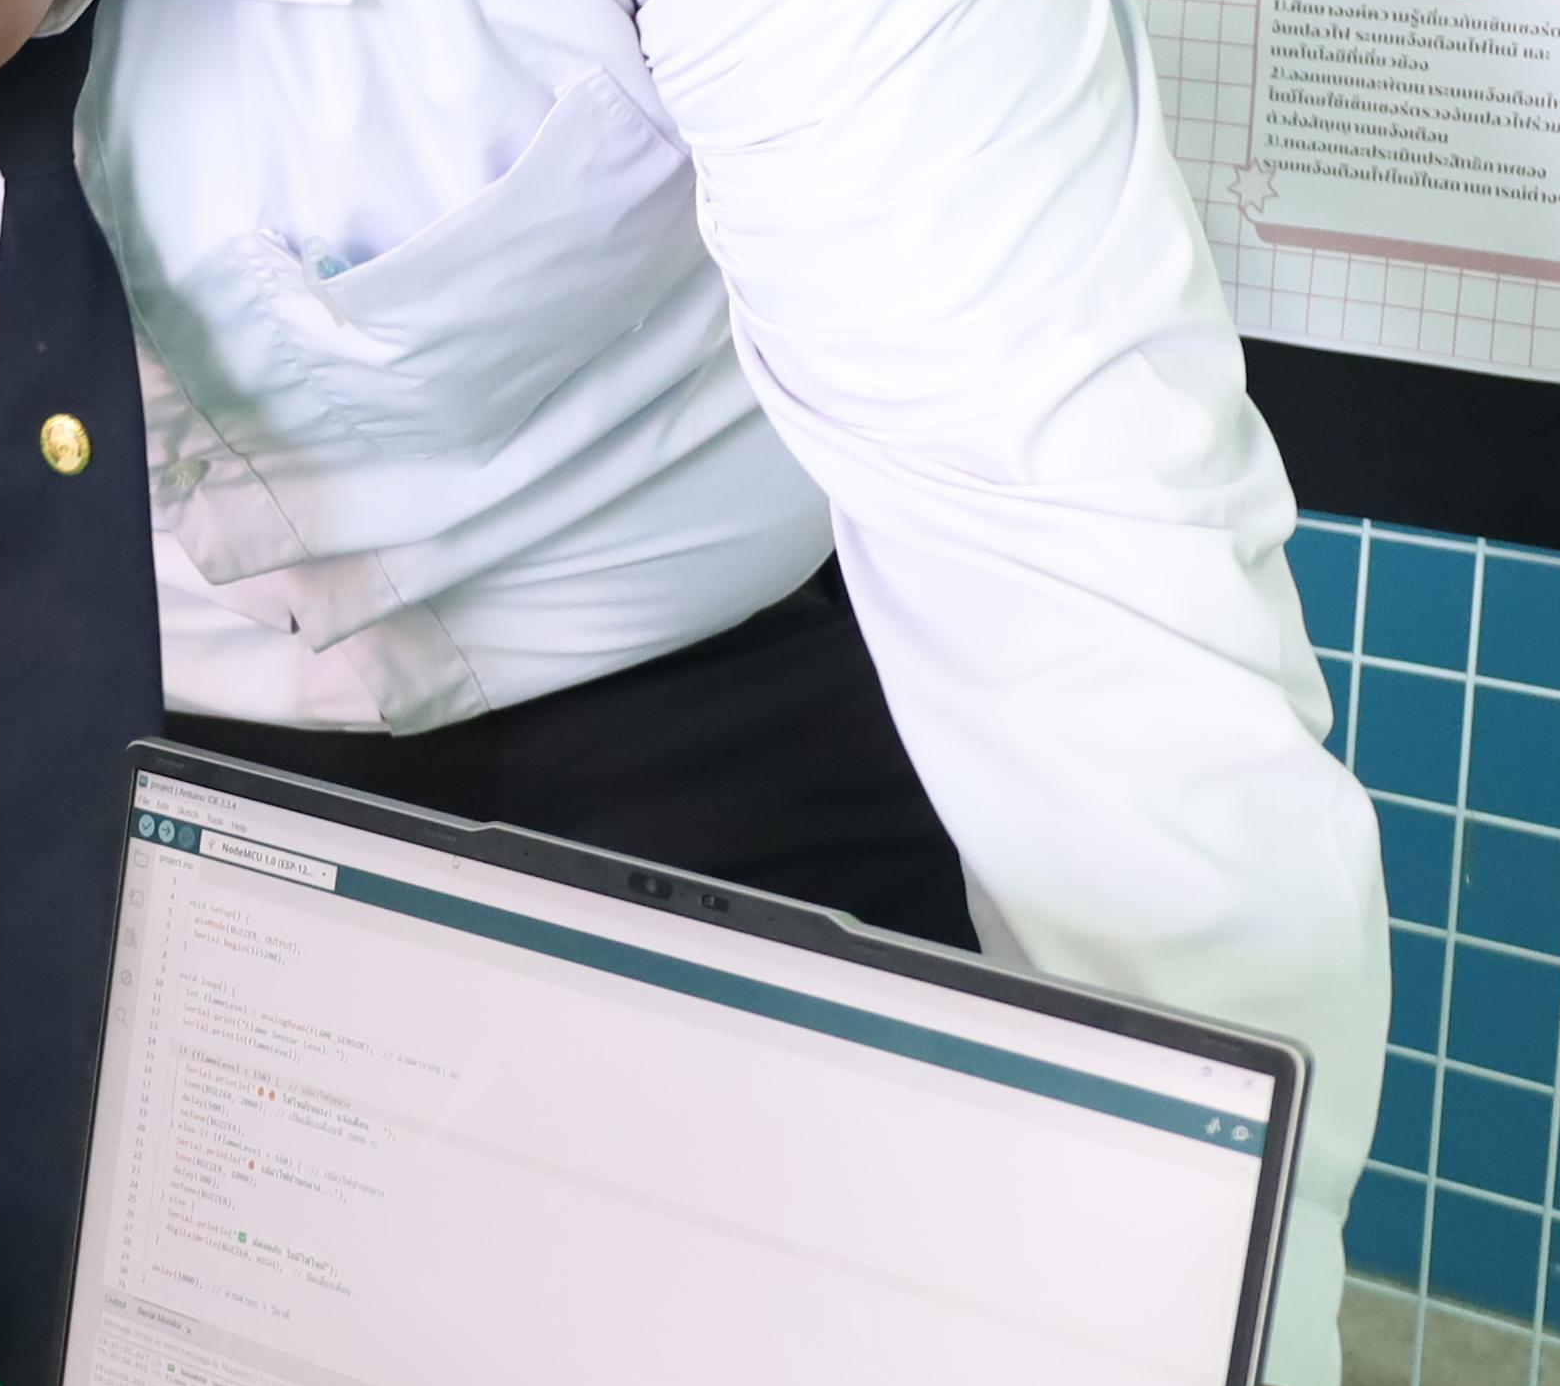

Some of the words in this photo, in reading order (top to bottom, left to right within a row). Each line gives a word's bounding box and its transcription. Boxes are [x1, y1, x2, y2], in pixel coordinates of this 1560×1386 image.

[179, 787, 205, 802] Arduino
[206, 795, 218, 806] IDE
[177, 805, 199, 819] Sketch
[207, 814, 224, 826] Tools
[231, 819, 248, 833] Help
[222, 843, 263, 863] NodeMCU
[265, 854, 276, 867] 1.0
